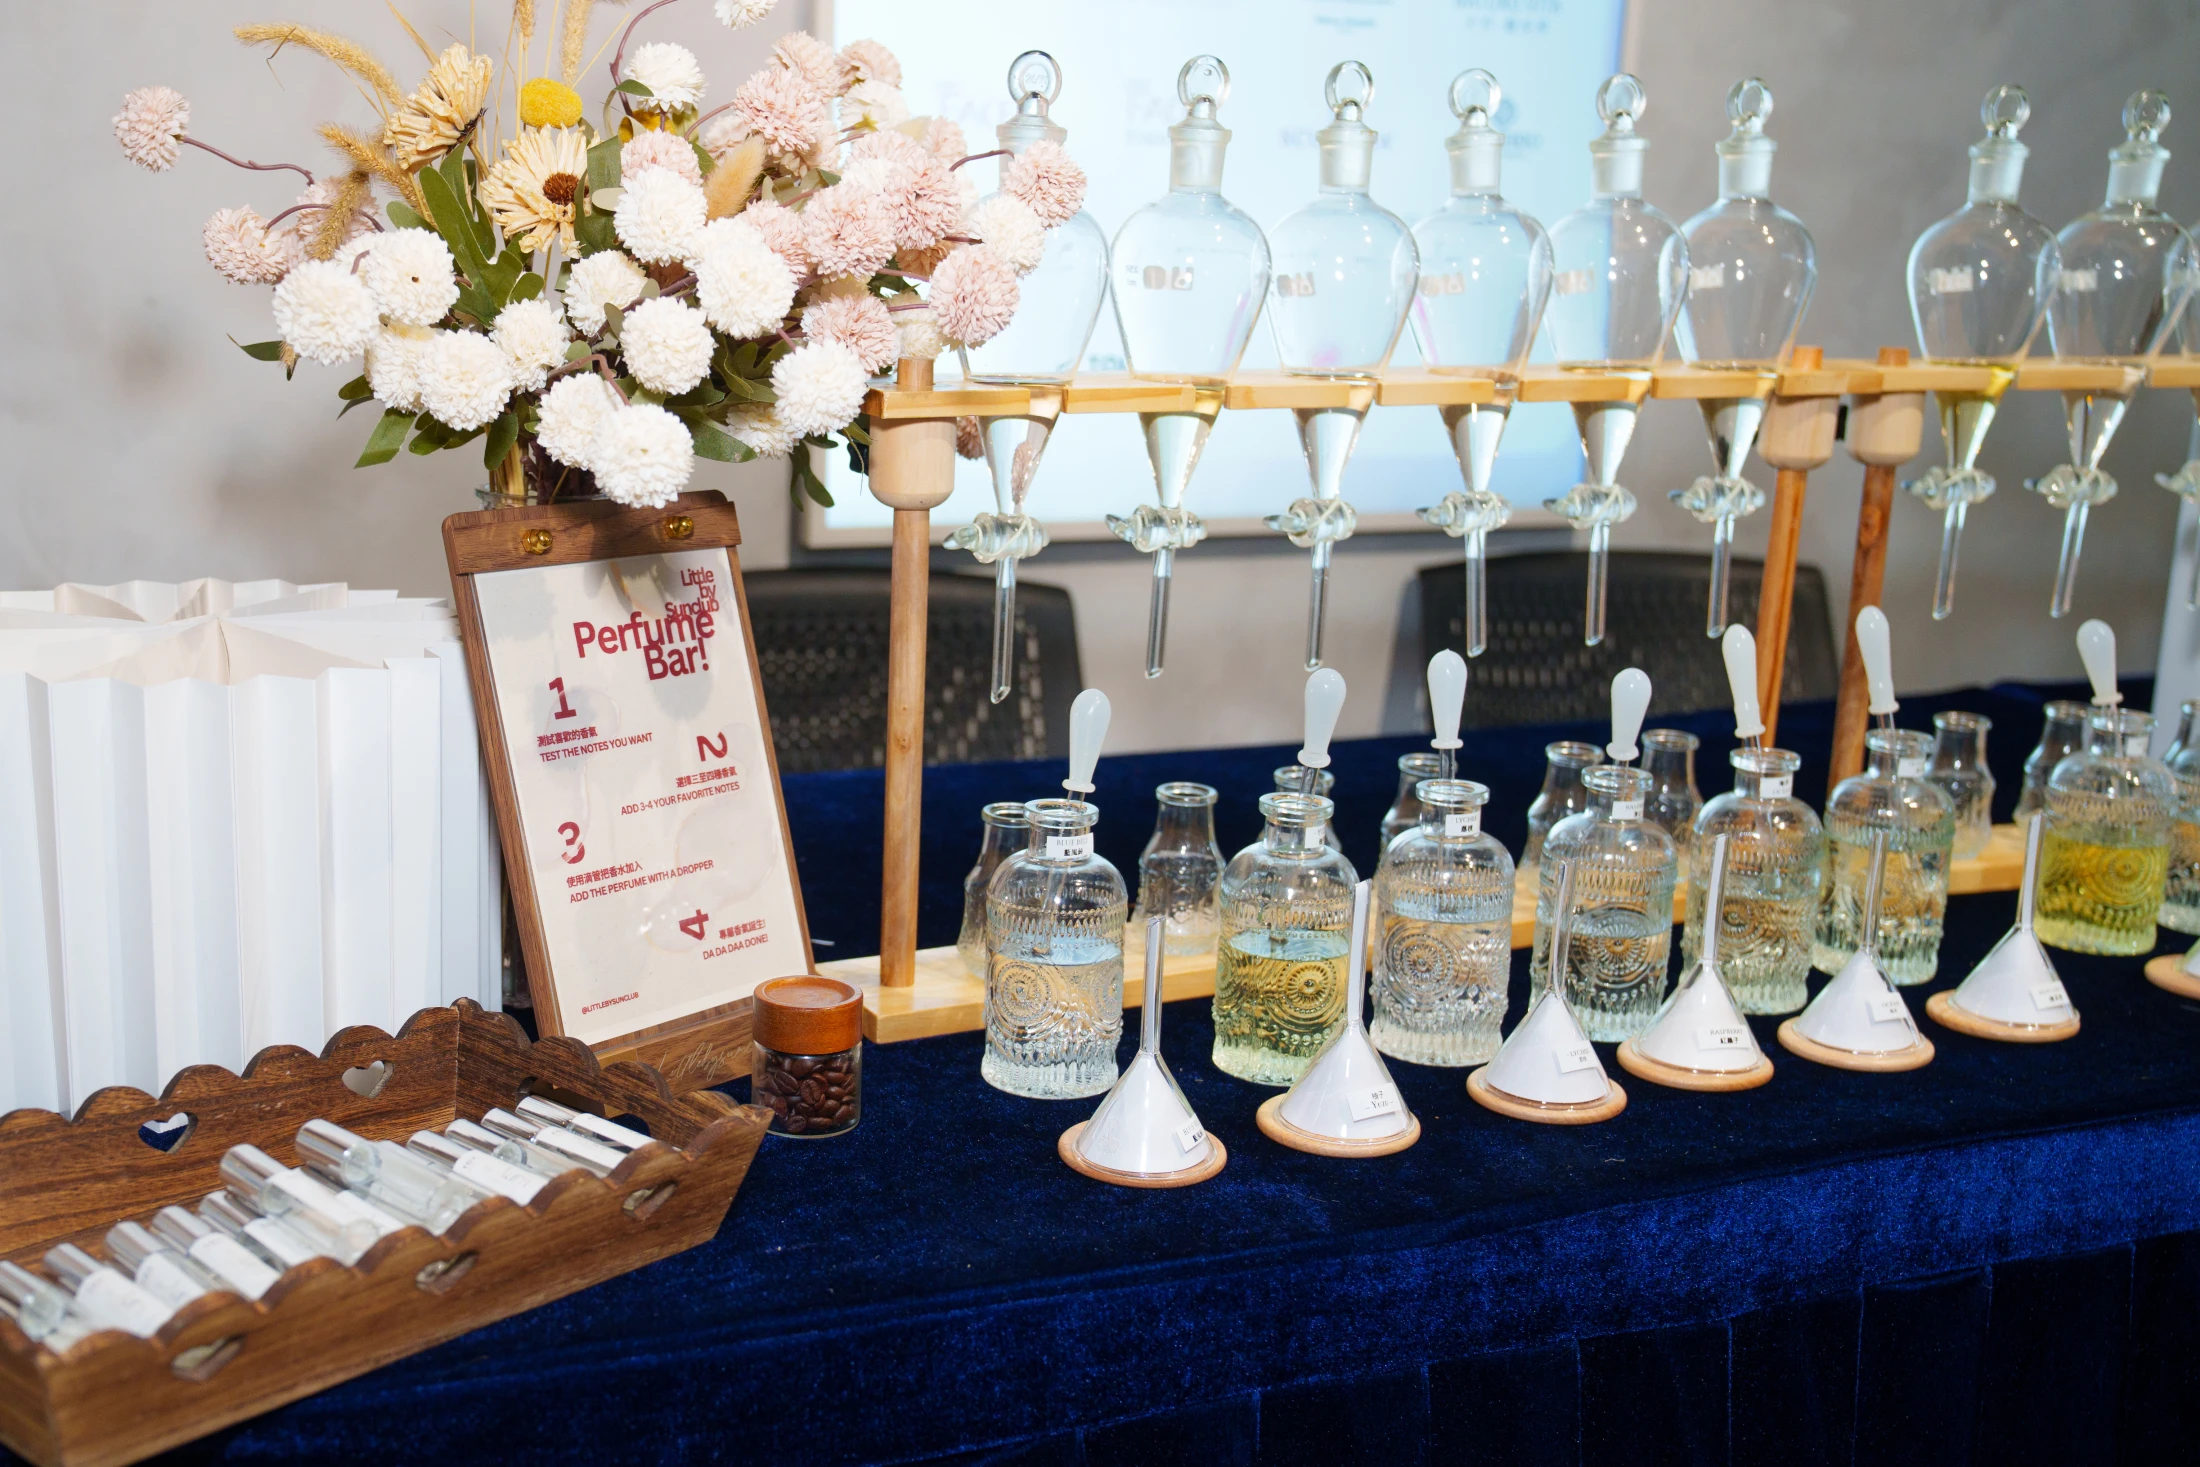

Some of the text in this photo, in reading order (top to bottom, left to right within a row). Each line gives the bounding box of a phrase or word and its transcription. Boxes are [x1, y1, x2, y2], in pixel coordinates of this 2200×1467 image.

[681, 567, 714, 586] Little
[699, 584, 716, 600] by
[665, 597, 719, 619] Sunclub
[573, 611, 715, 658] Perfume
[643, 637, 709, 680] Bar!
[548, 676, 577, 720] 1
[540, 732, 653, 762] TEST THE NOTES YOU WANT
[696, 731, 728, 762] 2
[621, 781, 740, 816] ADD 3-4 YOUR FAVORITE NOTES
[557, 821, 586, 865] 3
[566, 861, 643, 888] 使用滴管把香水加入
[570, 859, 714, 903] ADD THE PERFUME WITH A DROPPER
[678, 908, 709, 941] 4
[703, 933, 769, 960] DA DA DAA DONE!
[581, 991, 640, 1015] @LITTLEBYSUNCLUB
